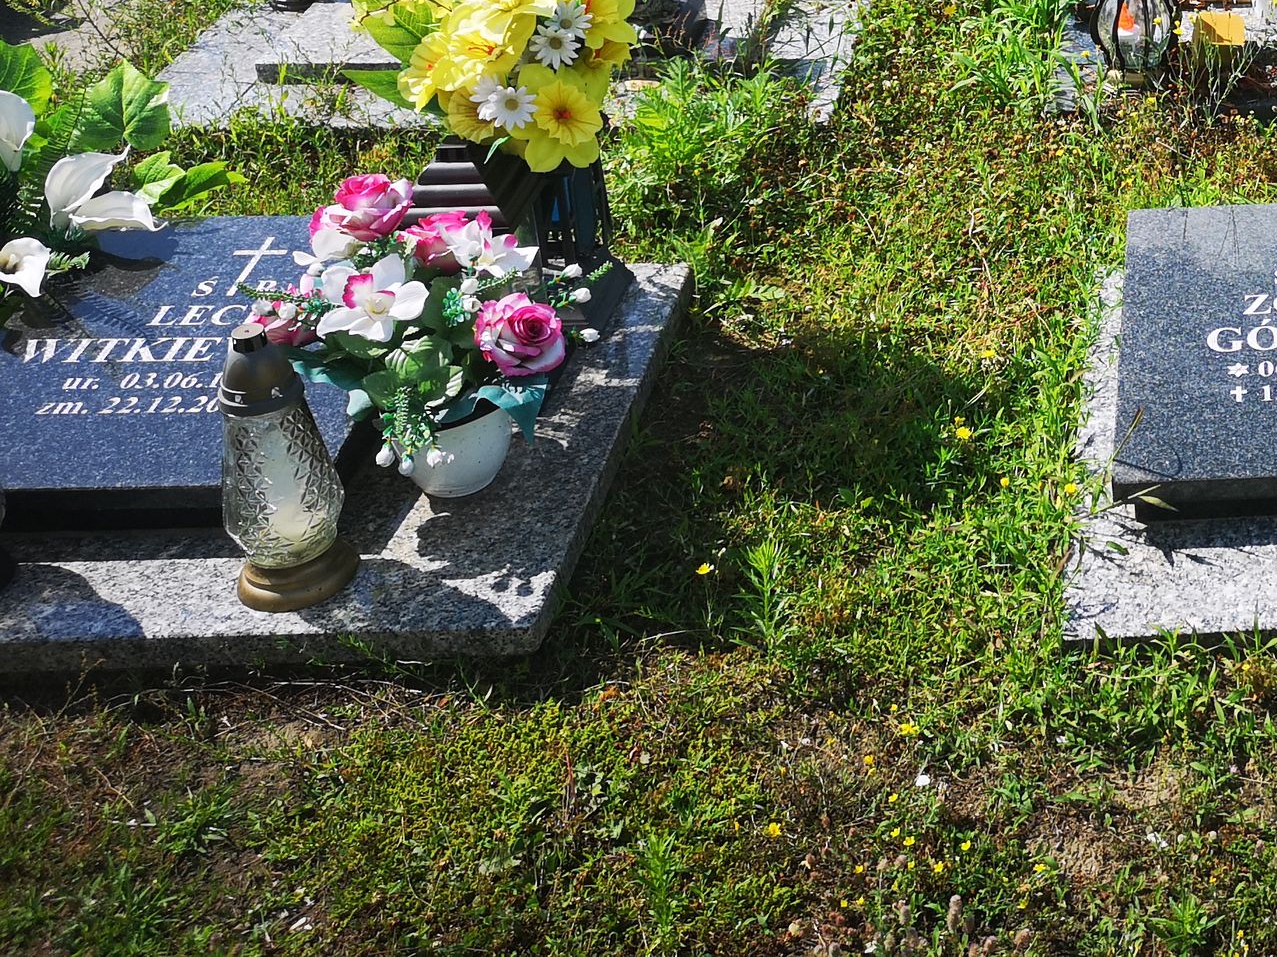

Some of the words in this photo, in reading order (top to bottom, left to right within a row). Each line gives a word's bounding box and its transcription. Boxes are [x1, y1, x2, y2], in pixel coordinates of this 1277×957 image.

[146, 304, 250, 327] LEC
[21, 337, 232, 364] WITKIE
[62, 376, 99, 390] ur.
[119, 372, 222, 390] 03.06.1
[35, 400, 87, 415] zm.
[98, 396, 221, 415] 22.12.20
